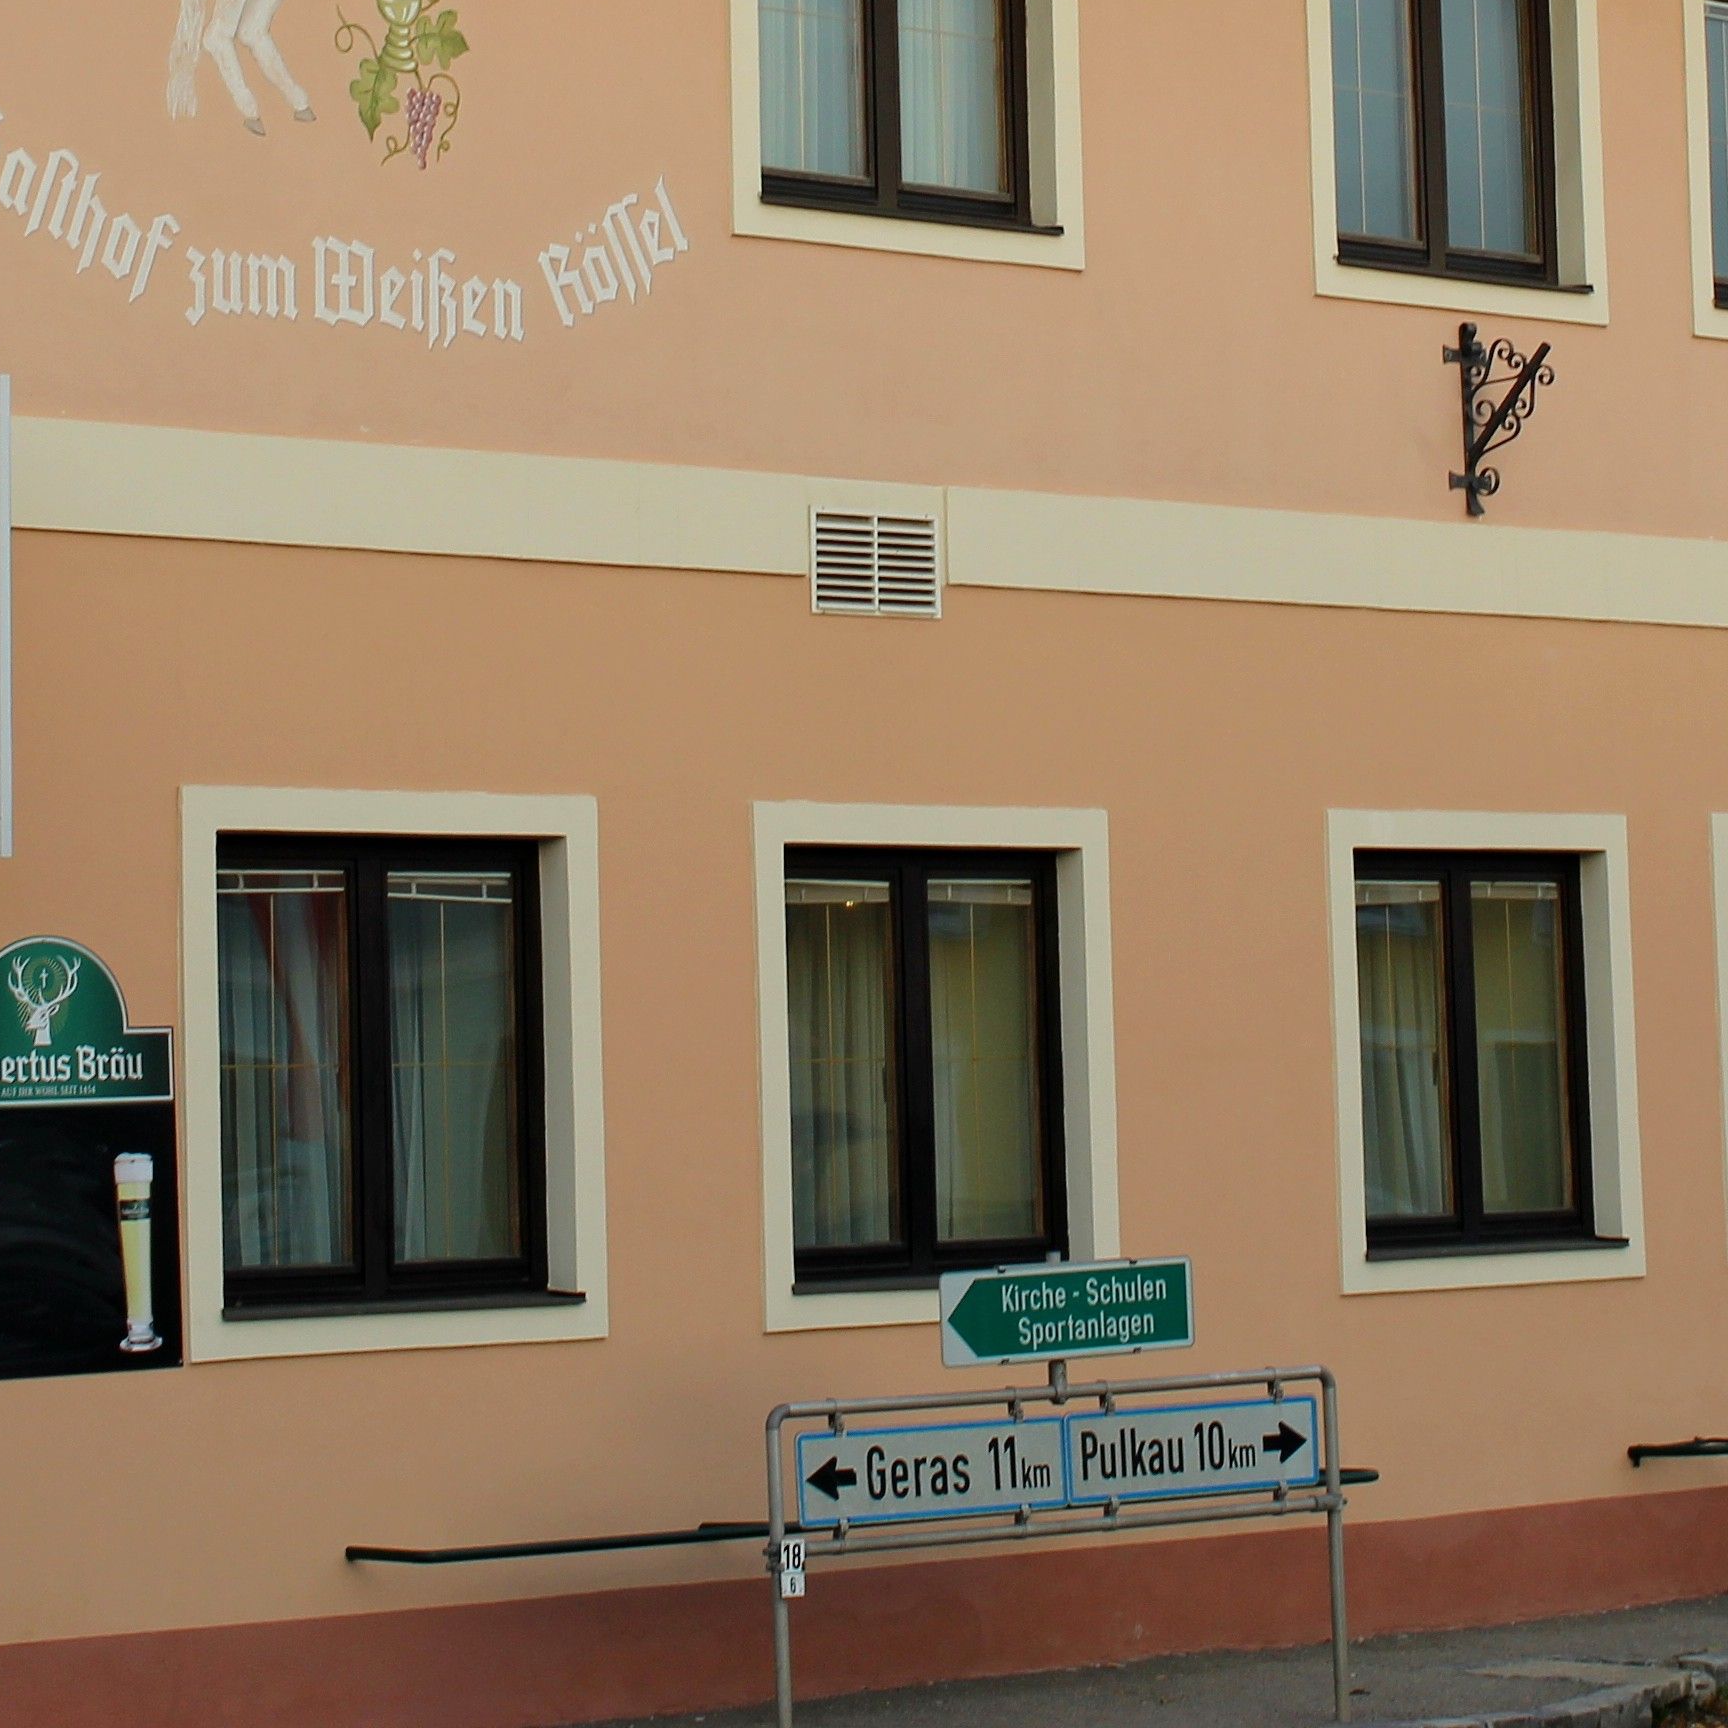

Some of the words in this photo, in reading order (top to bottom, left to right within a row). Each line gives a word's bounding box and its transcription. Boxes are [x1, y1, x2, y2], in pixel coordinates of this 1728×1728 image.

[183, 245, 299, 327] zum
[310, 233, 526, 350] Weißen
[75, 1043, 144, 1082] Bräu
[1001, 1281, 1066, 1313] Kirche
[1086, 1274, 1167, 1305] Schulen
[1018, 1310, 1155, 1351] Sportanlagen
[865, 1445, 971, 1501] Geras
[1080, 1425, 1185, 1482] Pulkau
[783, 1543, 801, 1570] 18
[790, 1576, 797, 1594] 6
